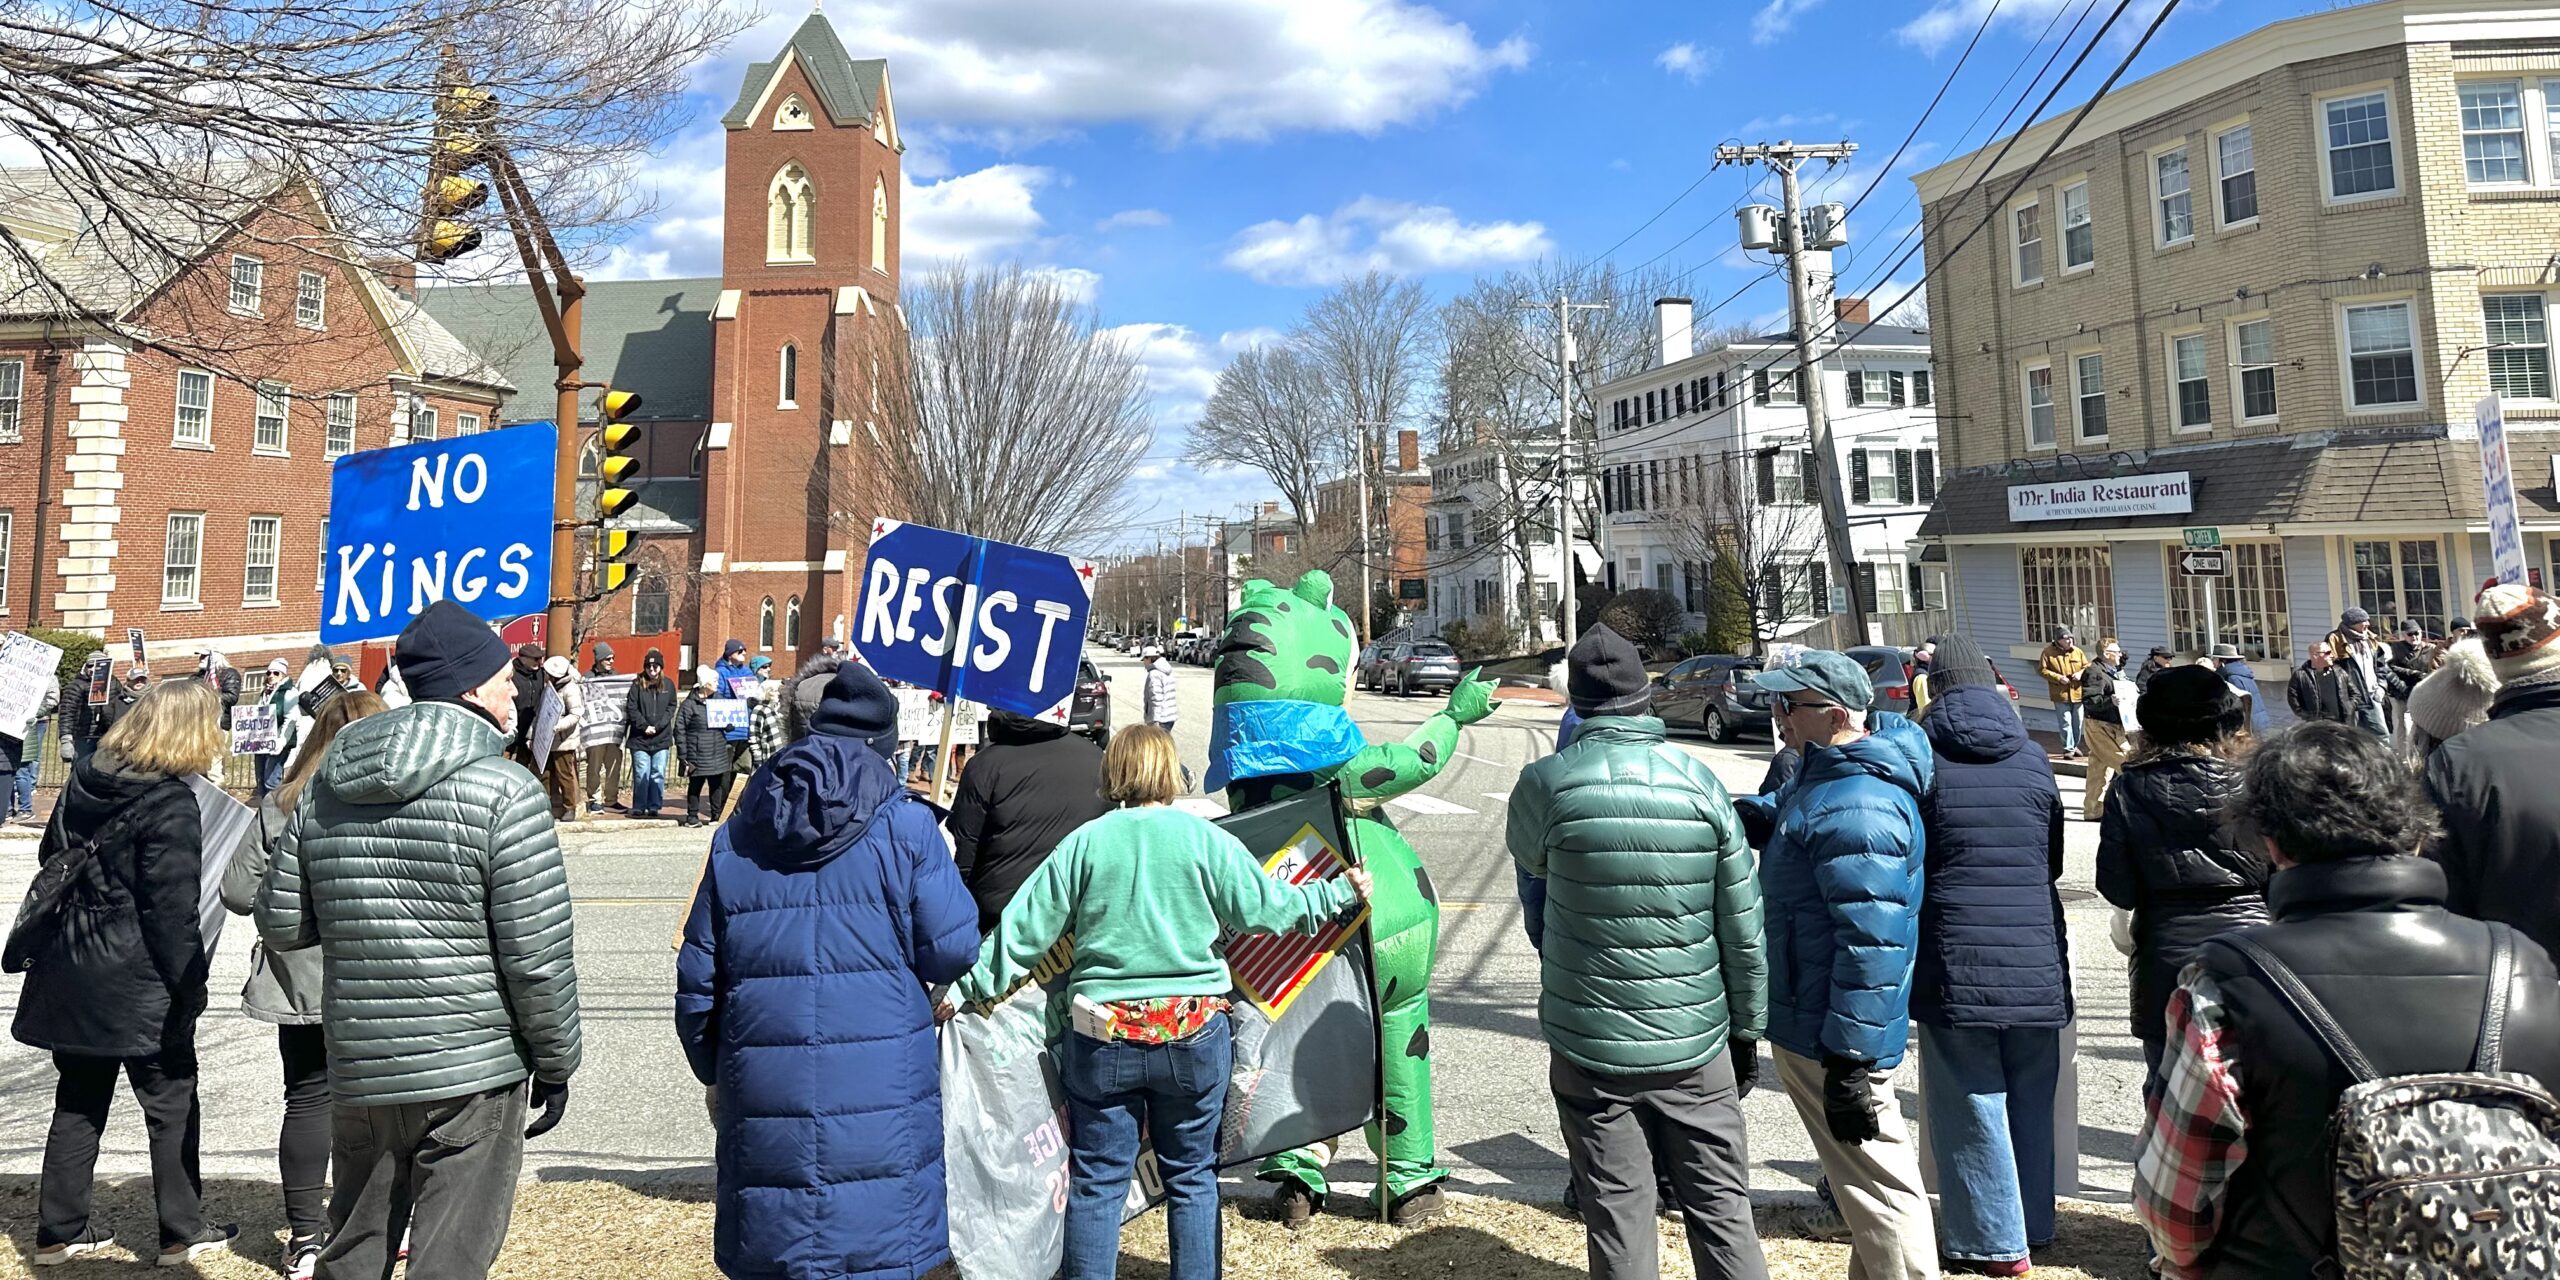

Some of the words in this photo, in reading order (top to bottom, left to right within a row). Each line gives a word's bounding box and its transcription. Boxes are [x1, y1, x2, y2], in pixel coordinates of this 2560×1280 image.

[406, 452, 487, 511] NO
[2019, 490, 2048, 506] Mr.
[2051, 486, 2086, 504] India
[2093, 479, 2188, 502] Restaurant
[2074, 506, 2094, 515] INDIAN
[2099, 505, 2131, 514] HIMALAYAN
[2132, 503, 2157, 512] CUISINE
[2193, 530, 2213, 544] GREEN
[2192, 558, 2206, 569] ONE
[2206, 558, 2220, 569] WAY
[861, 557, 1072, 694] RESIST
[7, 633, 32, 650] FIGHT
[33, 642, 51, 656] FOR
[236, 719, 254, 731] GREAT
